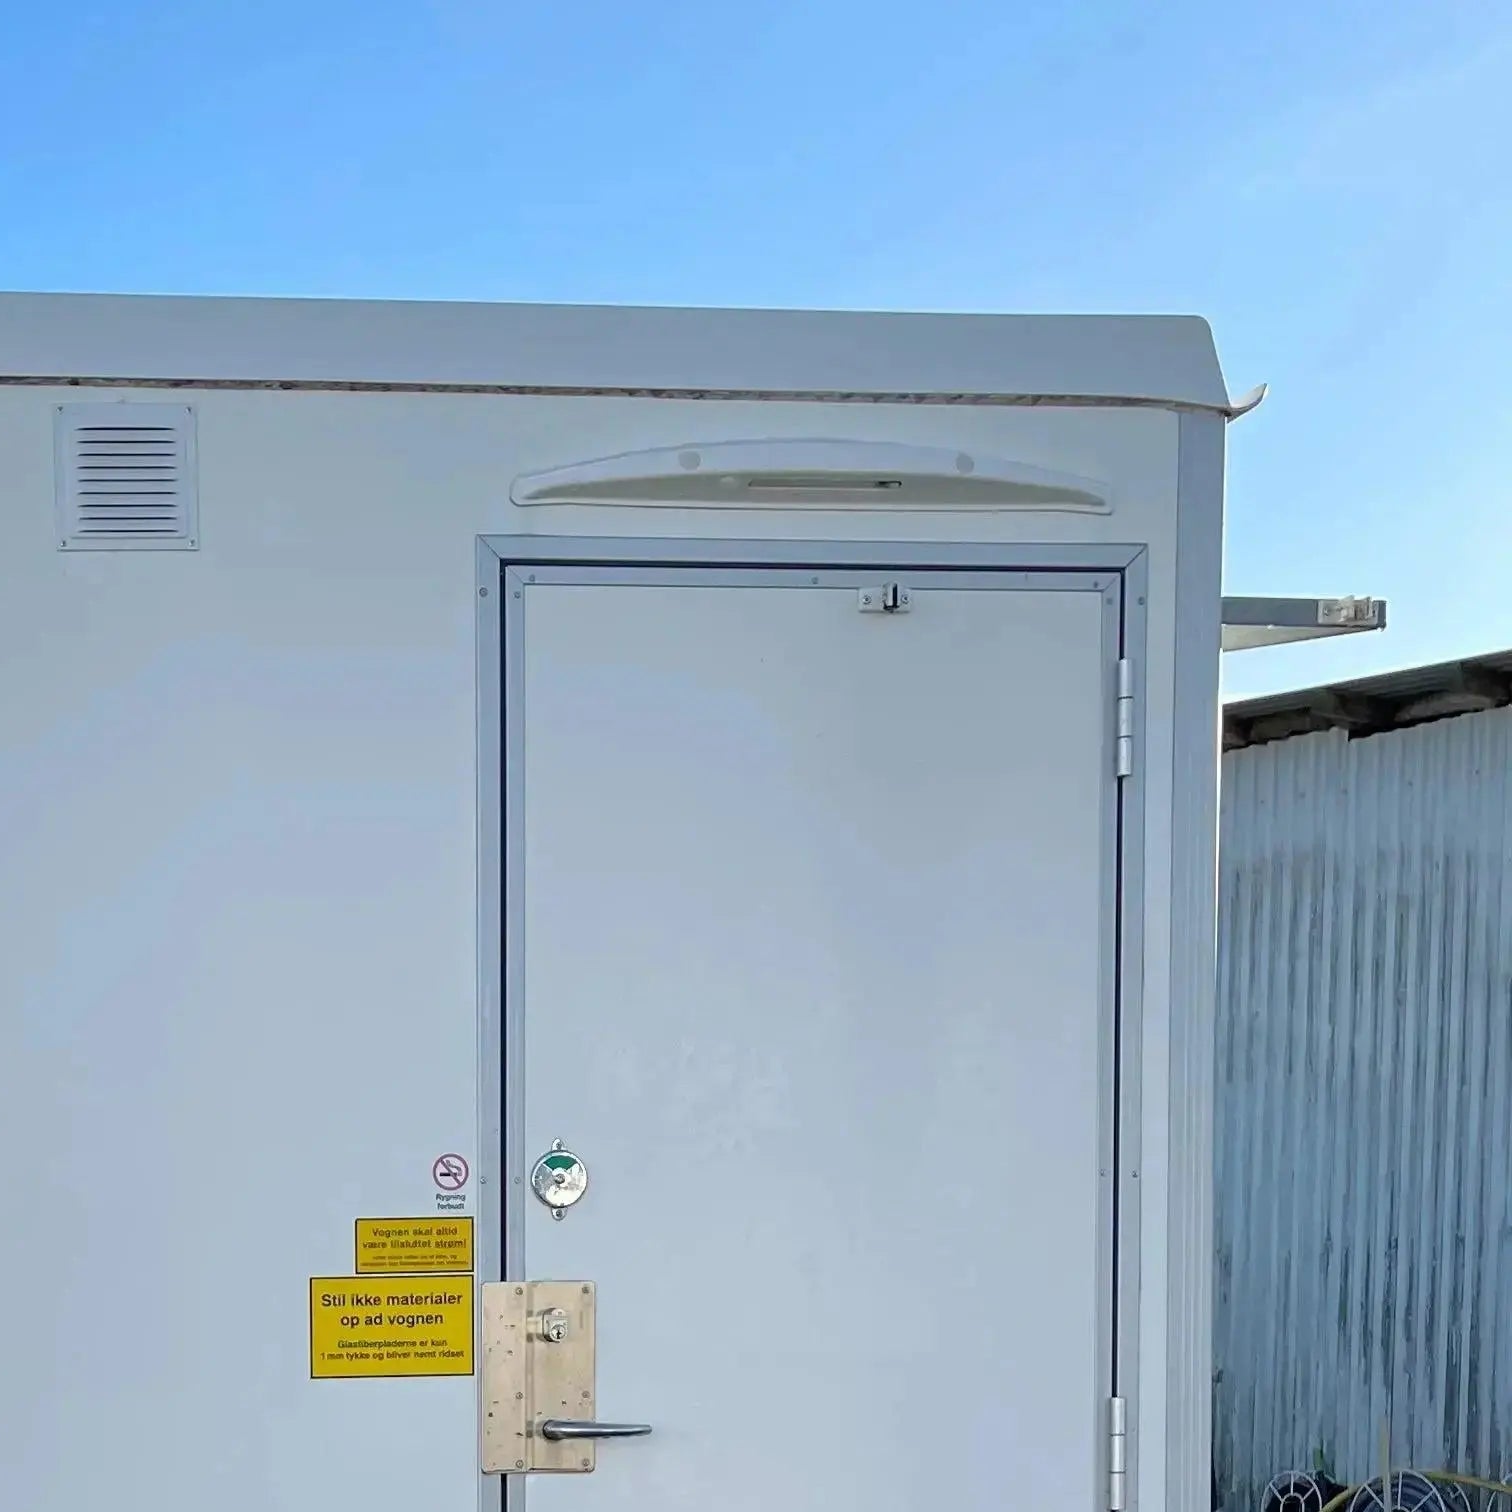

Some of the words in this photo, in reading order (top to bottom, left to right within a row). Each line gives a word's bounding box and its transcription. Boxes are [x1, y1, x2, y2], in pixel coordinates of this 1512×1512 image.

[372, 1227, 409, 1238] Vognen
[412, 1227, 433, 1236] skal
[436, 1226, 458, 1236] altid
[321, 1293, 346, 1307] Stil
[351, 1293, 382, 1307] ikke
[387, 1292, 463, 1306] materialer
[340, 1315, 360, 1328] op
[364, 1313, 383, 1326] ad
[388, 1313, 444, 1328] vognen
[430, 1339, 448, 1347] kun
[346, 1351, 370, 1361] tykke
[372, 1352, 384, 1361] og
[386, 1351, 411, 1359] bliver
[439, 1350, 465, 1358] ridset
